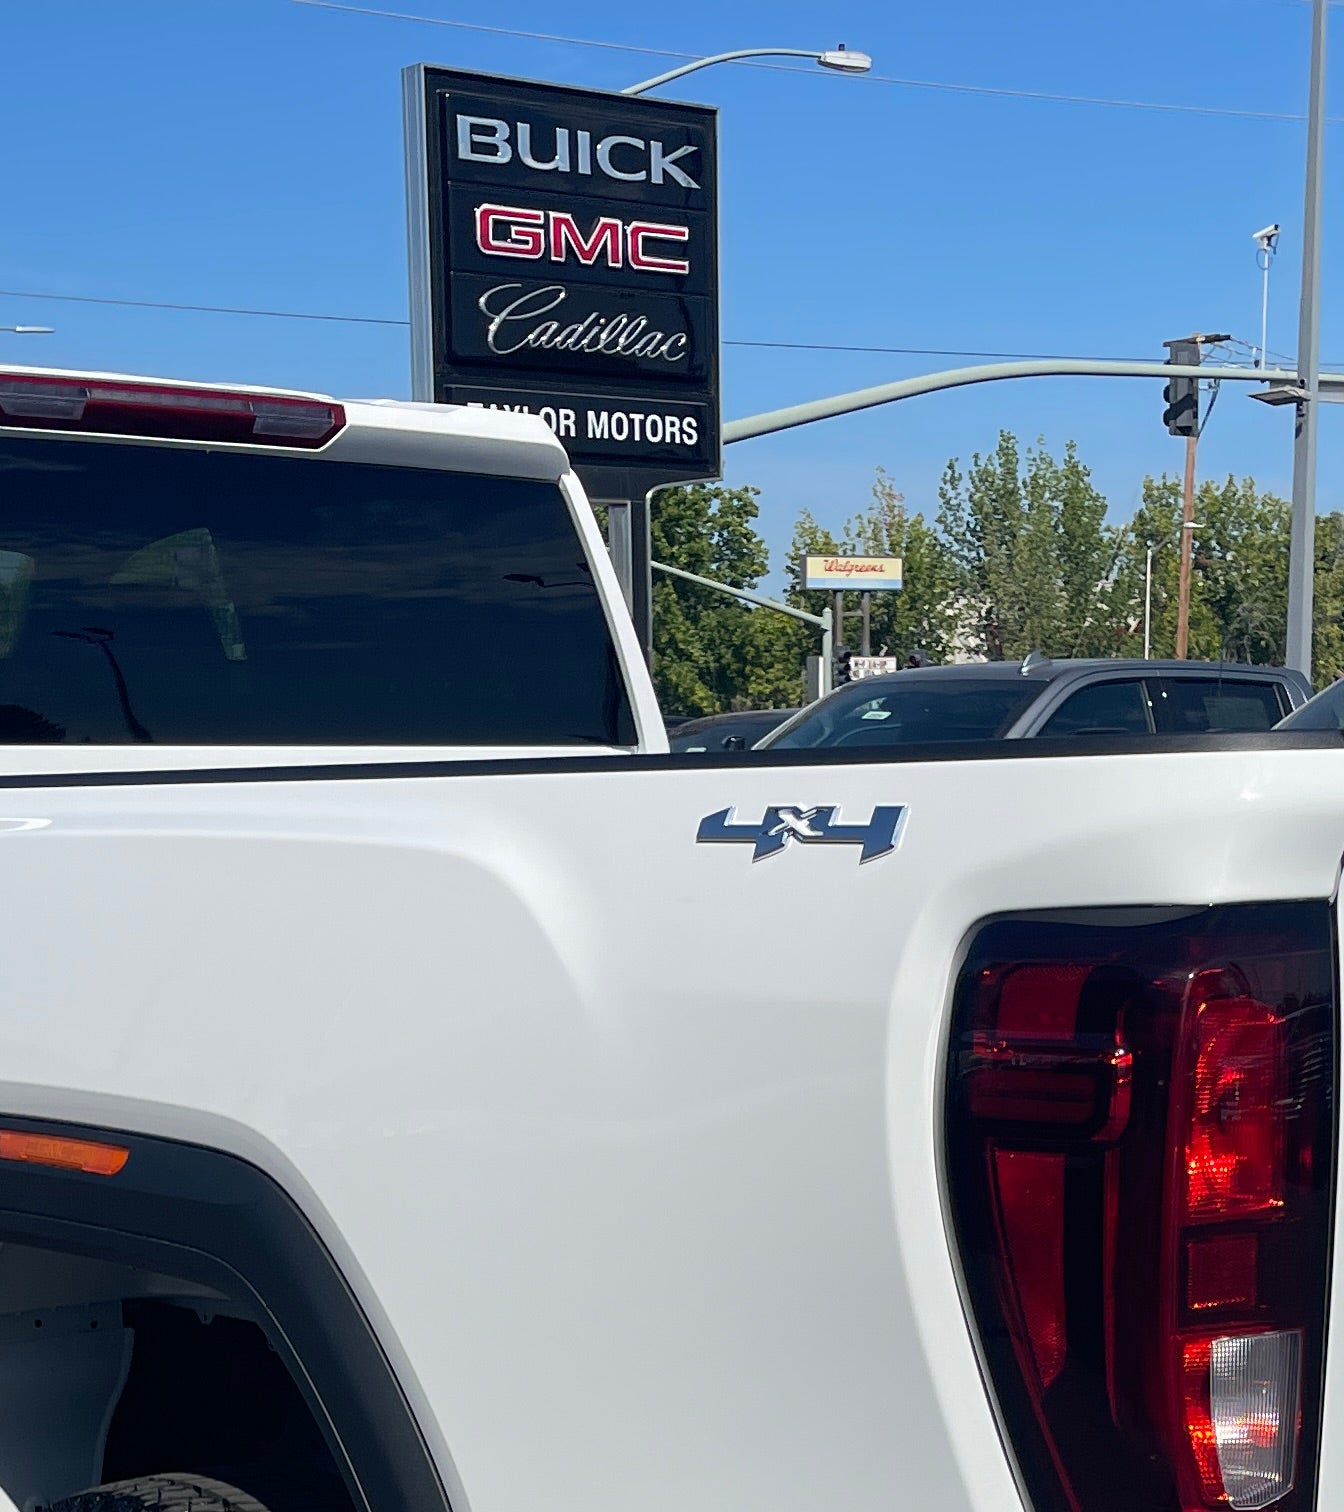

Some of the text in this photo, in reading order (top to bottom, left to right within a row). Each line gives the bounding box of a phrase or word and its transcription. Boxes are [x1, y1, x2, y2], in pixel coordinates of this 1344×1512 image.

[456, 113, 701, 190] BUICK
[474, 202, 690, 275] GMC
[478, 283, 688, 362] Cadillac
[586, 410, 698, 446] MOTORS
[823, 558, 886, 577] Walgreens
